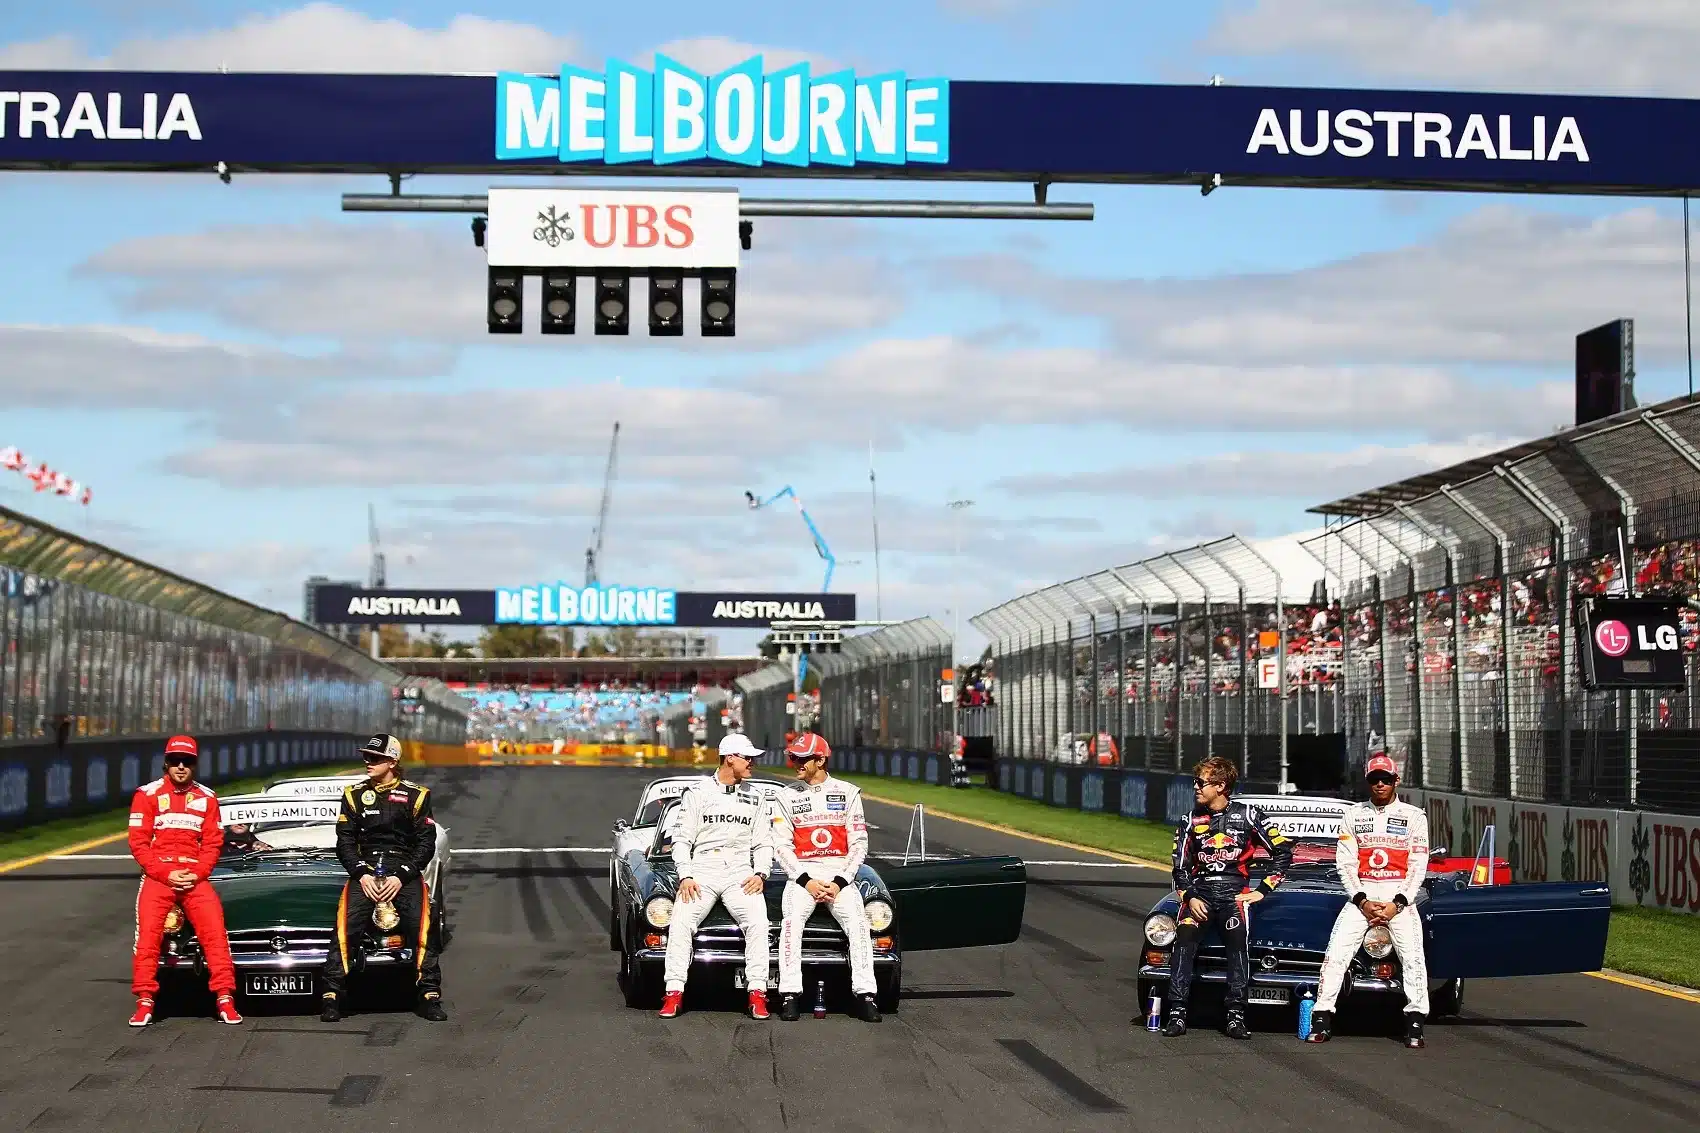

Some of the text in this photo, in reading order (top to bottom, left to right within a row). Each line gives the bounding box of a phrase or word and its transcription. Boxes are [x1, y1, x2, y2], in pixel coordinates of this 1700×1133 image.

[0, 91, 202, 141] TRALIA
[505, 68, 940, 157] MELBOURNE
[1246, 107, 1590, 163] AUSTRALIA
[579, 204, 694, 250] UBS
[347, 596, 461, 616] AUSTRALIA
[498, 586, 673, 622] MELBOURNE
[712, 600, 825, 619] AUSTRALIA
[1637, 624, 1679, 651] LG
[1263, 664, 1275, 682] F
[294, 785, 345, 795] KIMI RAIK
[659, 786, 685, 796] MICH
[229, 806, 337, 821] LEWIS HAMILTON
[793, 804, 811, 813] BOSS
[703, 814, 752, 826] PETRONAS
[1356, 824, 1373, 833] BOSS
[1520, 810, 1548, 881] UBS
[1576, 818, 1609, 882] UBS
[1198, 848, 1242, 863] Red Bull
[1653, 823, 1700, 913] UBS
[253, 976, 305, 991] GTSMRT
